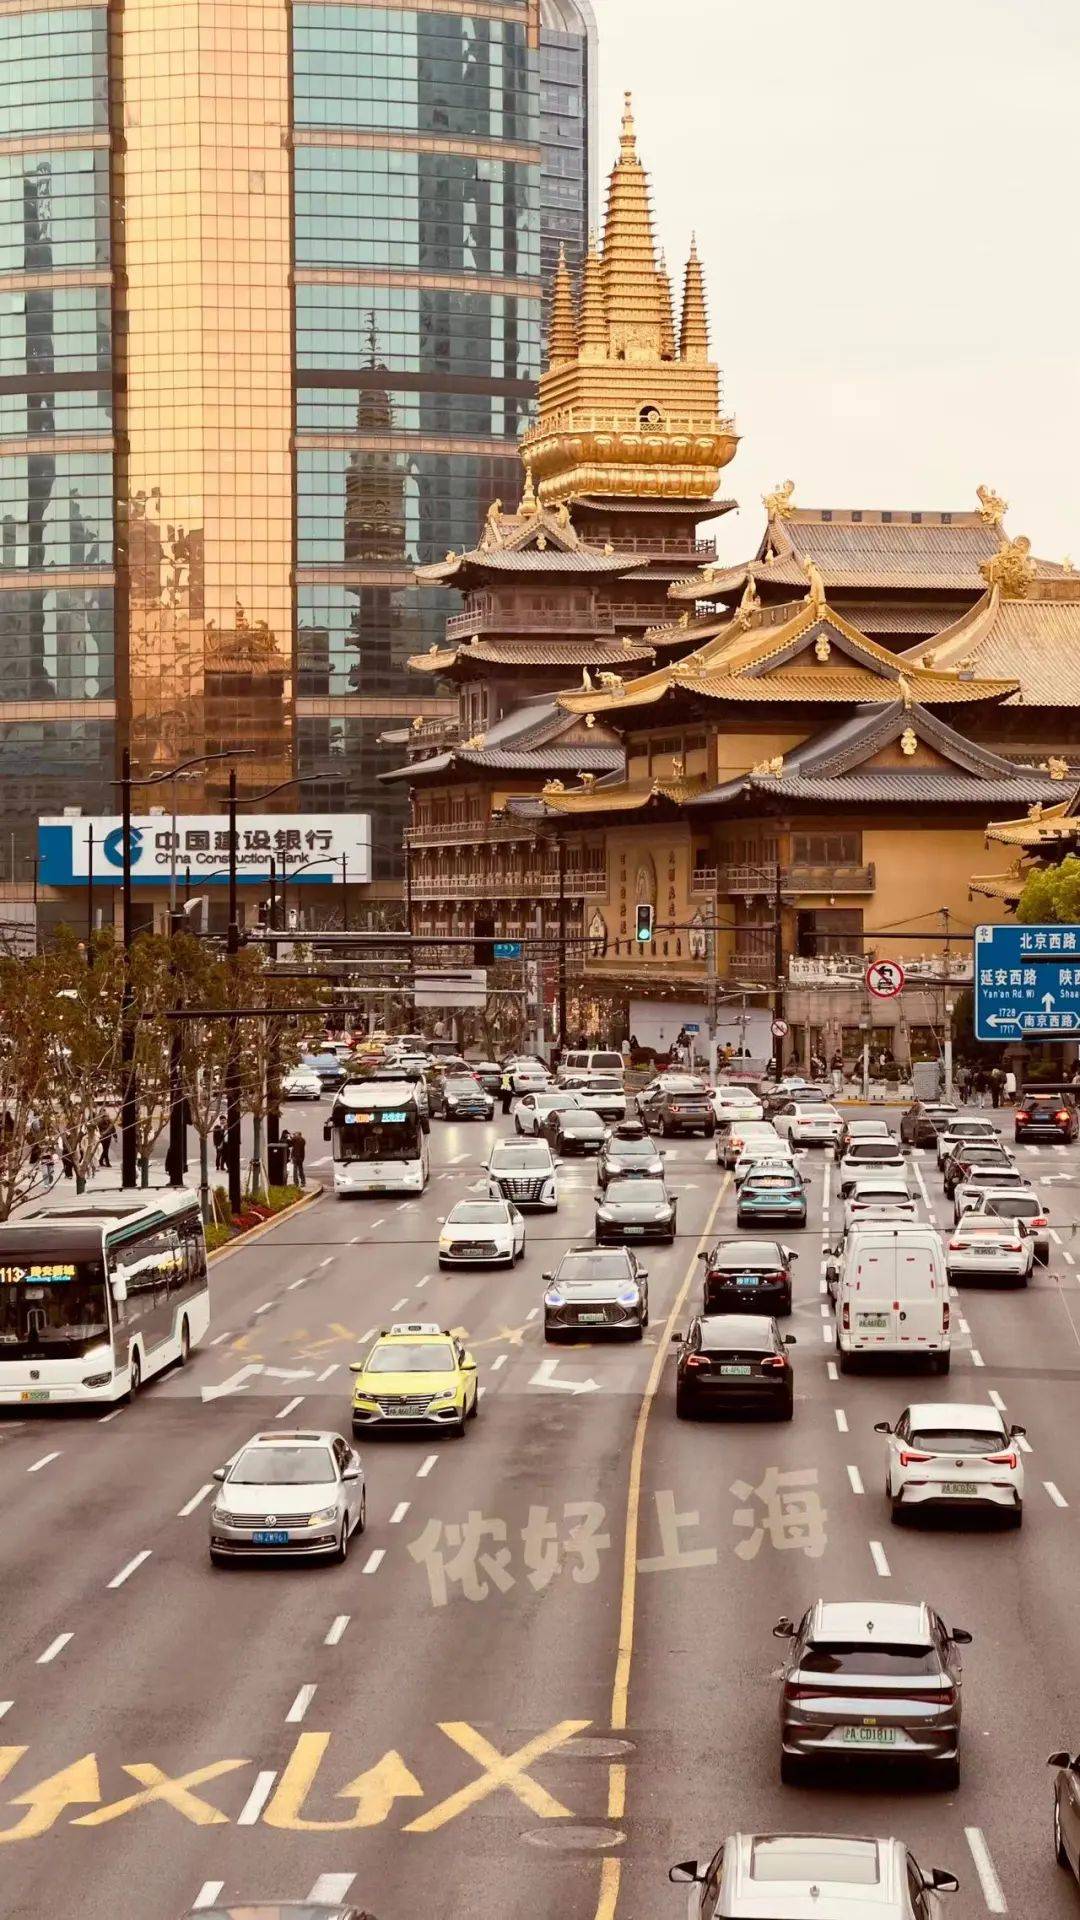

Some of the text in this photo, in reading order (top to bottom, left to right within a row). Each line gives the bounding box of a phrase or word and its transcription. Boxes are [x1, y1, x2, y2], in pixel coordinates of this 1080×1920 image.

[155, 829, 333, 850] 中国建设银行
[1020, 932, 1076, 949] 北京西路
[980, 968, 1037, 986] 延安西路
[999, 1008, 1016, 1018] 1728
[1024, 1014, 1073, 1028] 南京西路
[1000, 1025, 1015, 1035] 1717
